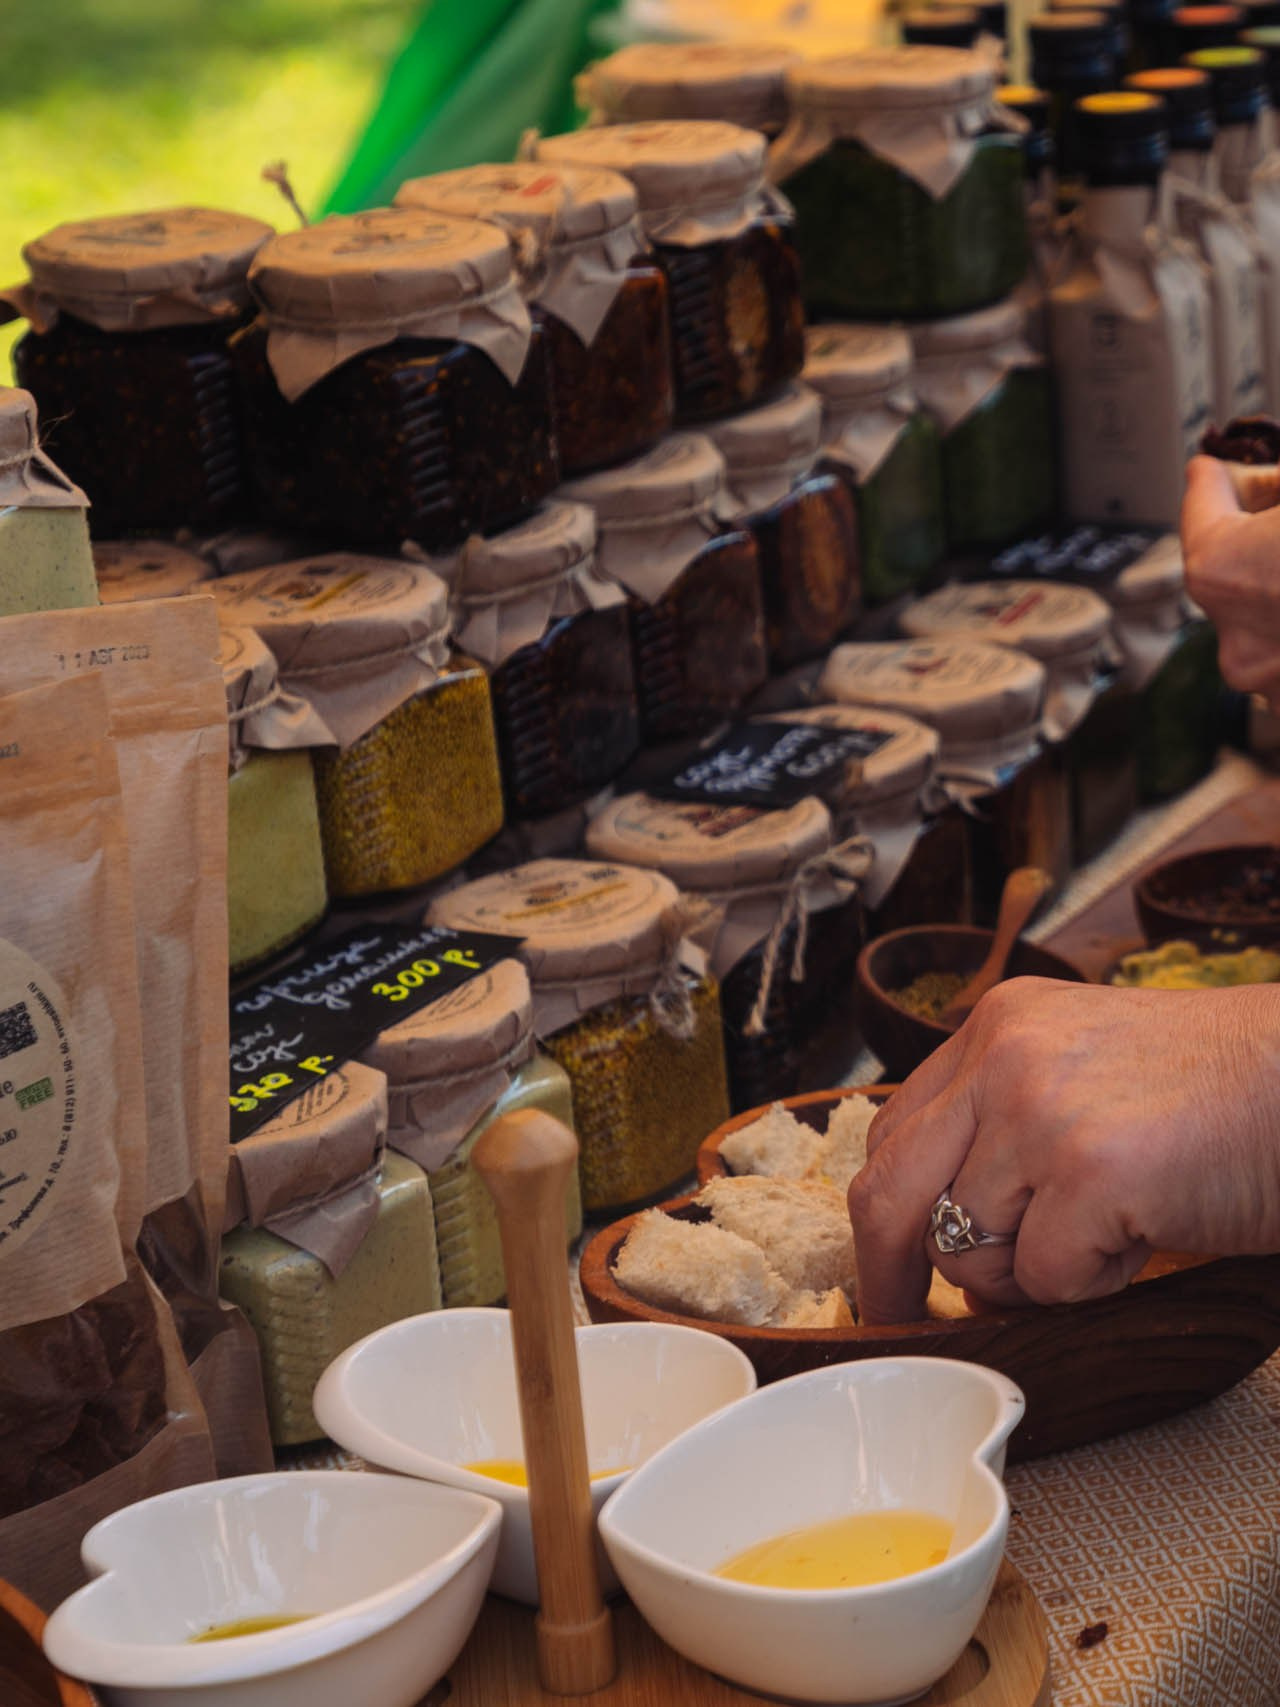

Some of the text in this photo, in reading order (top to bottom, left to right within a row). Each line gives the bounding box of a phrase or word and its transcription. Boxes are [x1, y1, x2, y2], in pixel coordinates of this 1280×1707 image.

[372, 959, 441, 1001] 300
[19, 1088, 55, 1111] FREE
[63, 1096, 76, 1123] (812)
